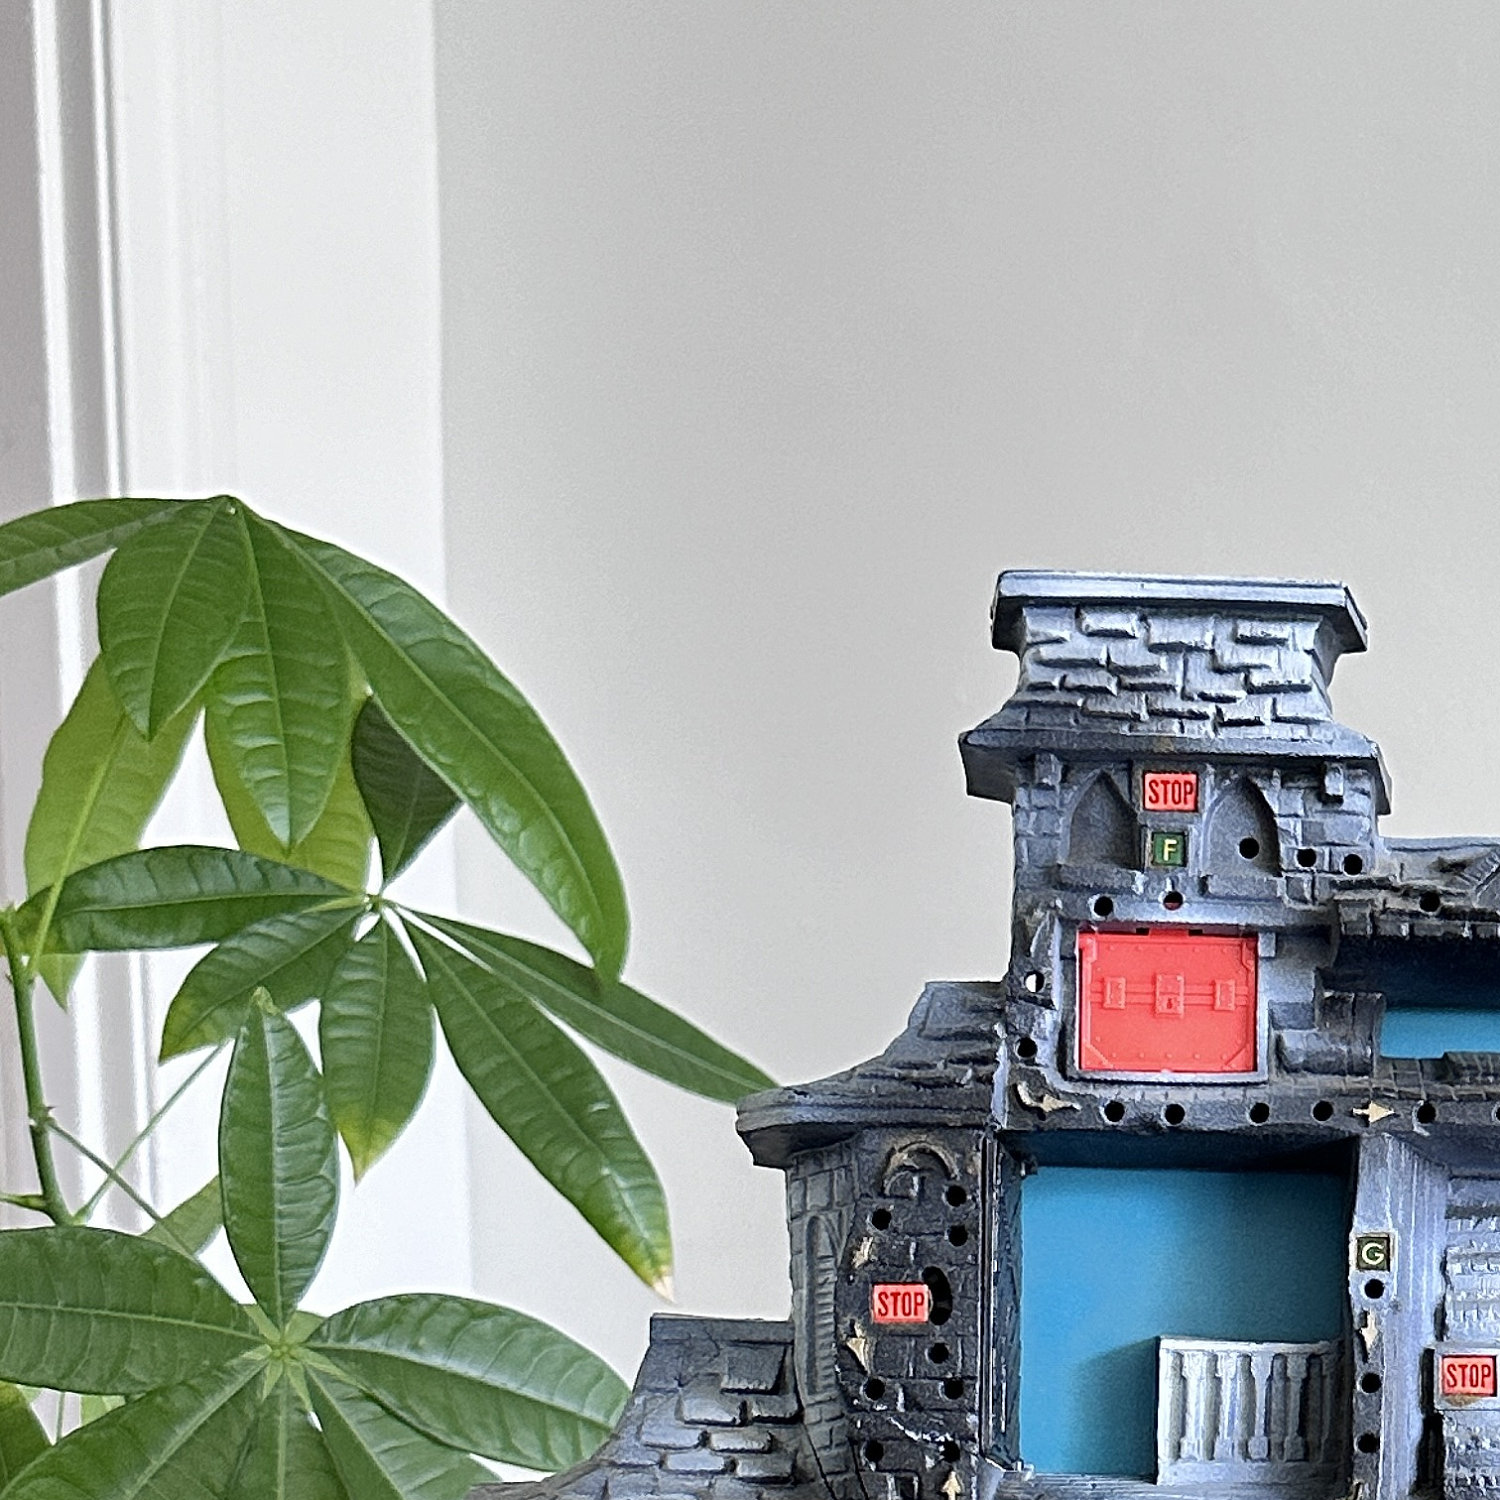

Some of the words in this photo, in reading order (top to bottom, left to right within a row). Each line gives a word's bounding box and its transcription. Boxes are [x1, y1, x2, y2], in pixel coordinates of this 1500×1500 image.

[1148, 779, 1193, 804] STOP
[1164, 839, 1178, 861] F
[1361, 1242, 1385, 1265] G
[878, 1291, 925, 1317] STOP
[1446, 1363, 1491, 1388] STOP
